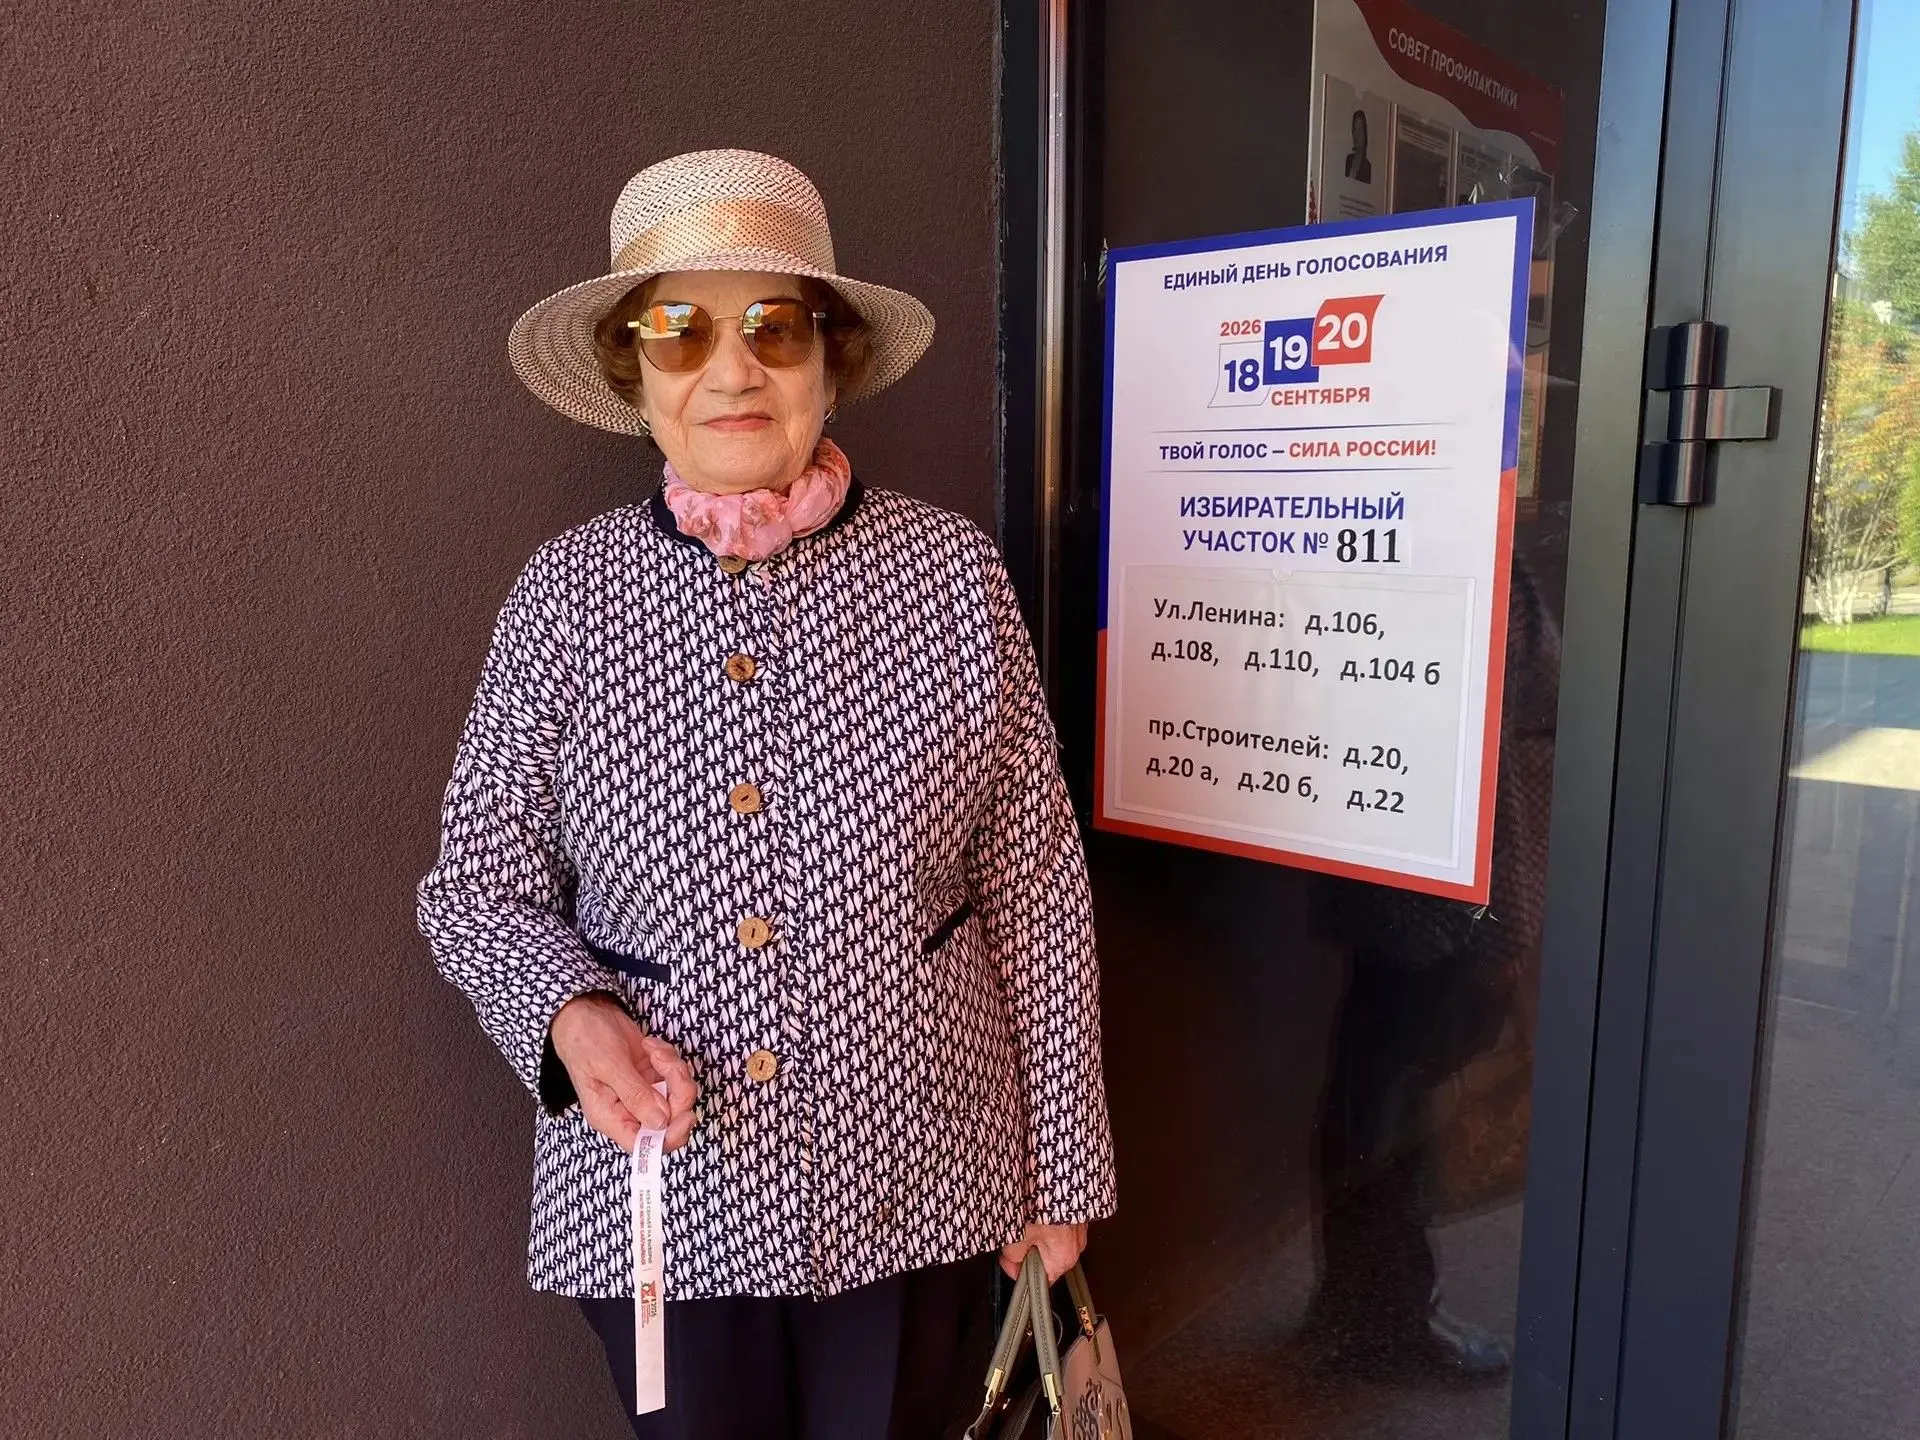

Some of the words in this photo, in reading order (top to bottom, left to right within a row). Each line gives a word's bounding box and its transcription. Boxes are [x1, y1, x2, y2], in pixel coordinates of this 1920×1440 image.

[1389, 28, 1430, 63] СОВЕТ
[1431, 49, 1519, 109] ПРОФИЛАКТИКИ
[1164, 264, 1238, 291] ЕДИНЫЙ
[1242, 262, 1291, 284] ДЕНЬ
[1296, 245, 1448, 276] ГОЛОСОВАНИЯ
[1220, 319, 1262, 337] 2026
[1224, 358, 1260, 393] 18
[1269, 335, 1308, 372] 19
[1317, 312, 1368, 351] 20
[1271, 387, 1370, 406] СЕНТЯБРЯ
[1159, 441, 1204, 460] ТВОЙ
[1208, 443, 1268, 460] ГОЛОС
[1289, 442, 1341, 458] СИЛА
[1346, 439, 1437, 457] РОССИИ!
[1180, 491, 1405, 520] ИЗБИРАТЕЛЬНЫЙ
[1182, 529, 1296, 553] УЧАСТОК
[1302, 531, 1329, 554] №
[1336, 528, 1401, 564] 811
[1153, 598, 1285, 628] Ул.Ленина:
[1304, 611, 1386, 640] д.106,
[1151, 639, 1220, 667] д.108,
[1244, 648, 1320, 678] д.110,
[1340, 657, 1416, 683] д.104
[1148, 718, 1330, 760] пр.Строителей:
[1342, 746, 1410, 775] д.20,
[1145, 756, 1194, 778] д.20
[1237, 770, 1291, 794] д.20
[1346, 788, 1405, 814] д.22
